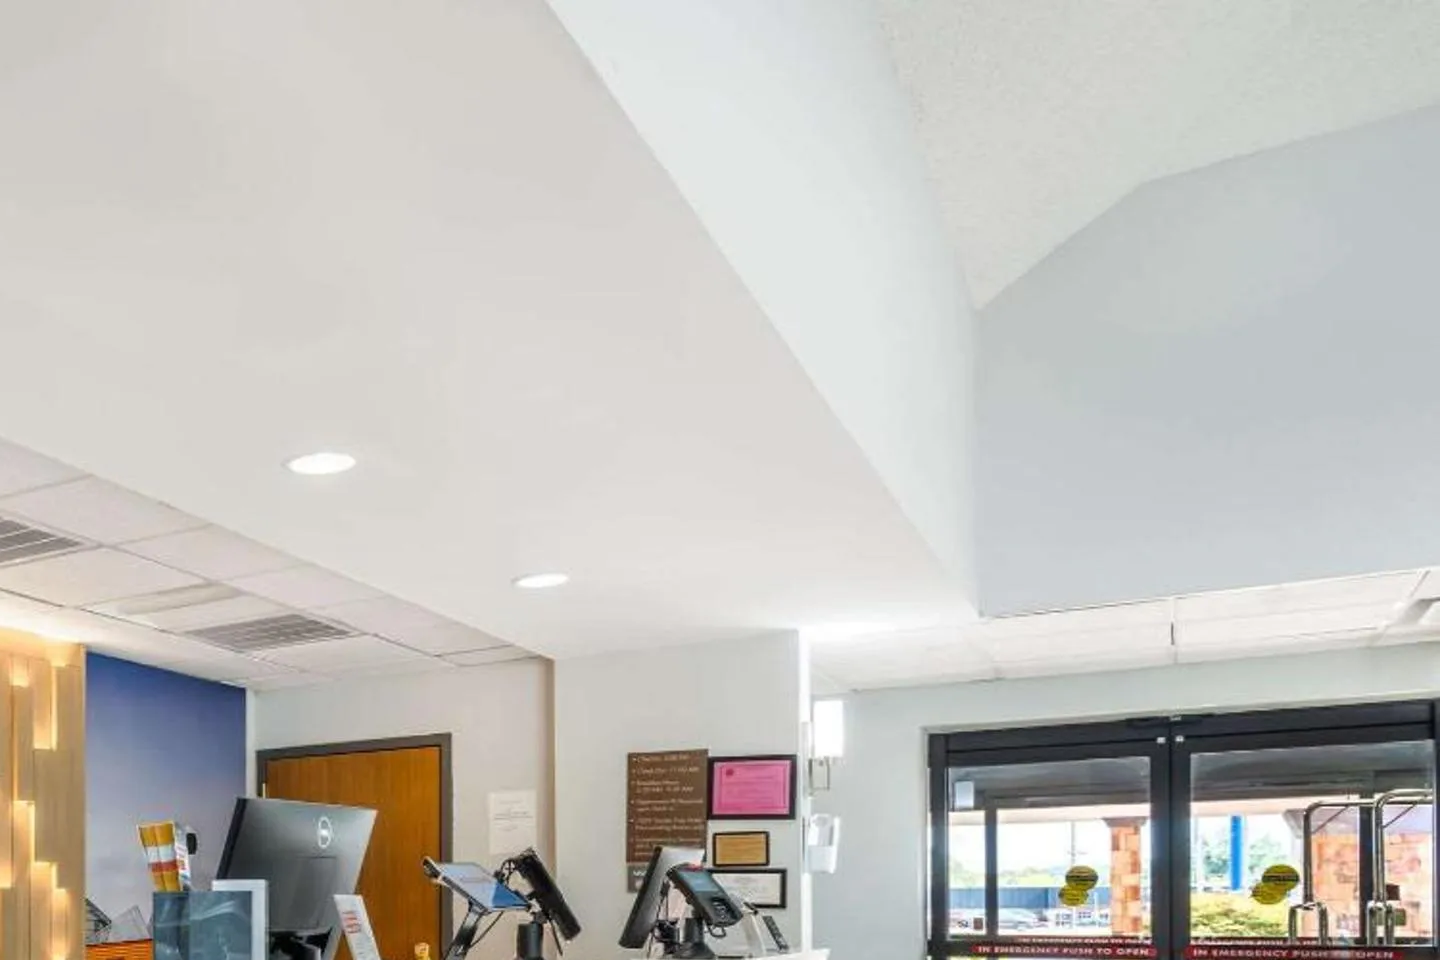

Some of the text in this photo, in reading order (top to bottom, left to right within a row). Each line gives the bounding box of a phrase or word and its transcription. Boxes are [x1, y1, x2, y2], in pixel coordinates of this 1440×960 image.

[977, 945, 1149, 957] IN EMERGENCY PUSH TO OPEN
[1193, 948, 1208, 957] IN
[1211, 948, 1289, 957] EMERGENCY
[1292, 949, 1328, 959] PUSH
